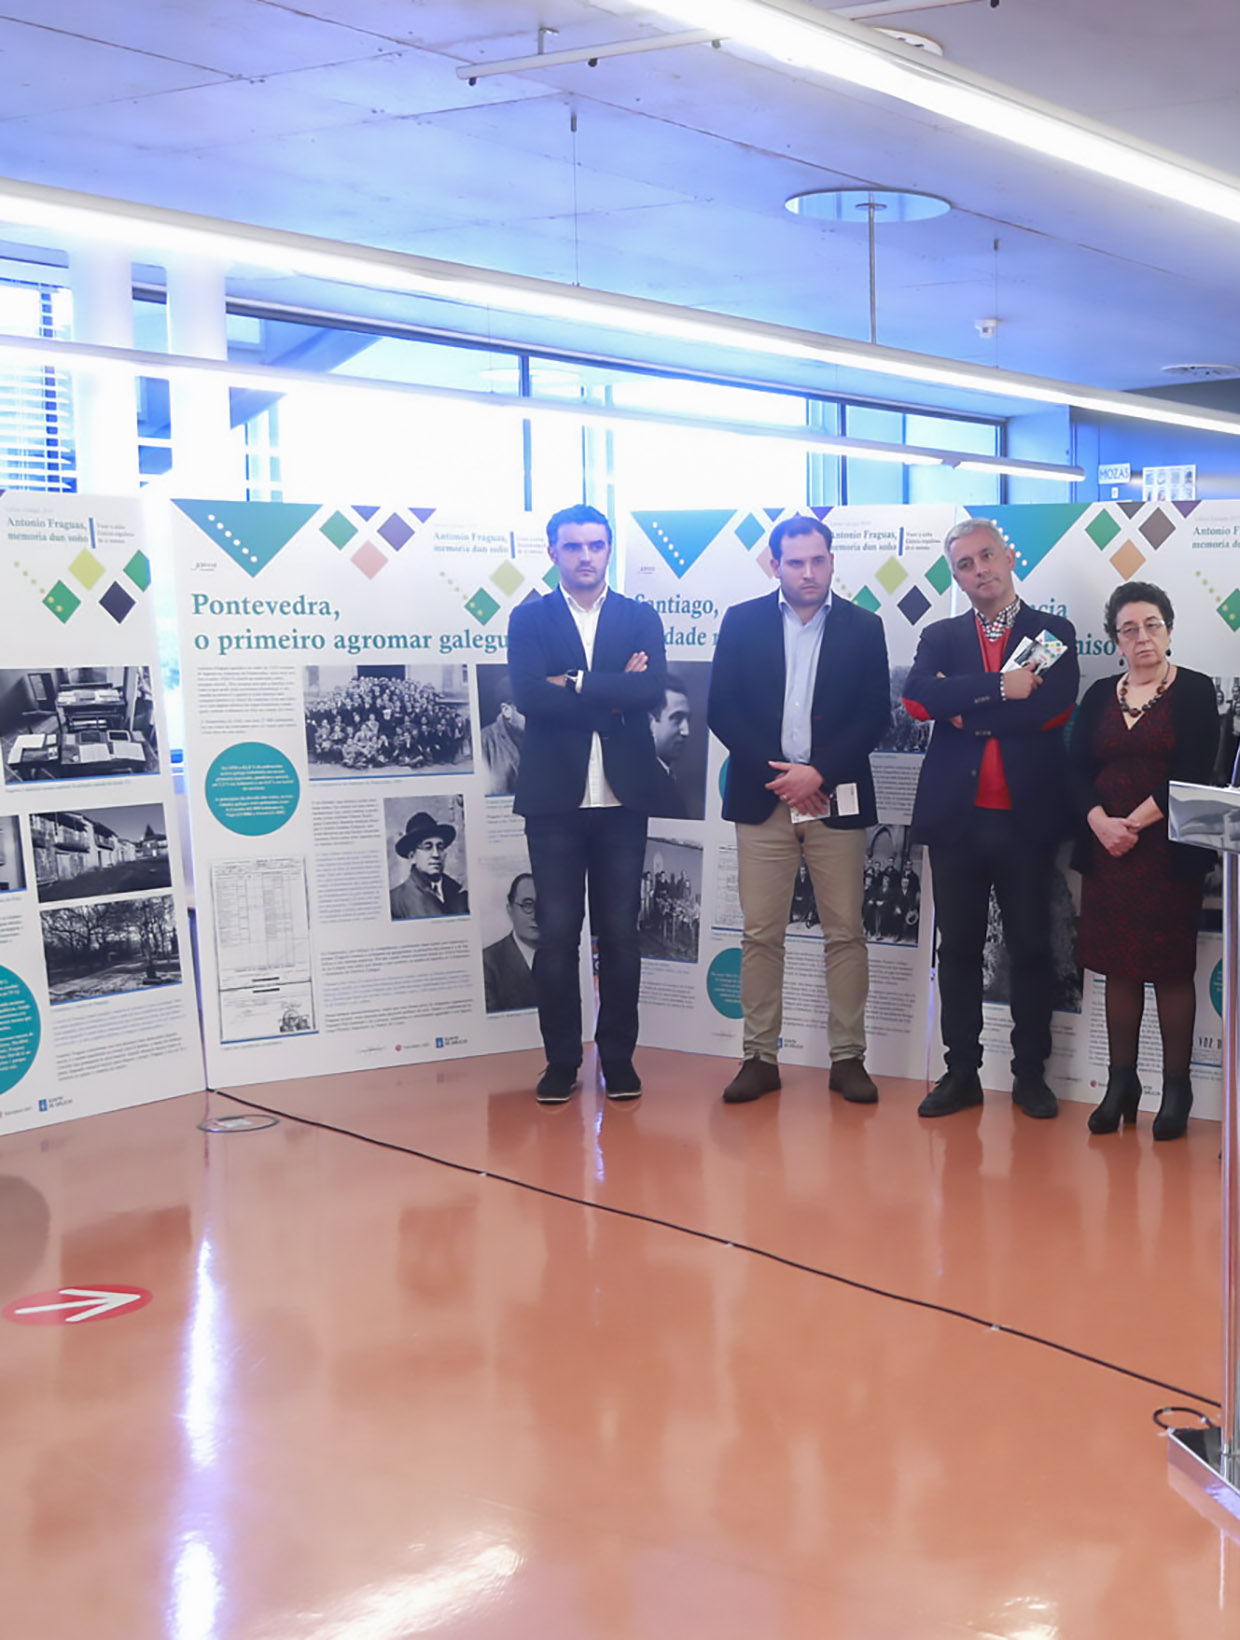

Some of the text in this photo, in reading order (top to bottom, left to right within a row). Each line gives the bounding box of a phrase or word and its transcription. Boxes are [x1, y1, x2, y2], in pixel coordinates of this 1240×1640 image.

[7, 516, 88, 531] Antonio Fraguas,
[1193, 526, 1231, 536] Antonio
[833, 530, 862, 539] ntonio
[864, 530, 897, 541] Fraguas,
[1192, 539, 1230, 549] memoria
[192, 593, 341, 621] Pontevedra,
[635, 593, 718, 619] ntiago,
[194, 628, 510, 656] o primeiro agromar galegu
[664, 626, 707, 646] dade
